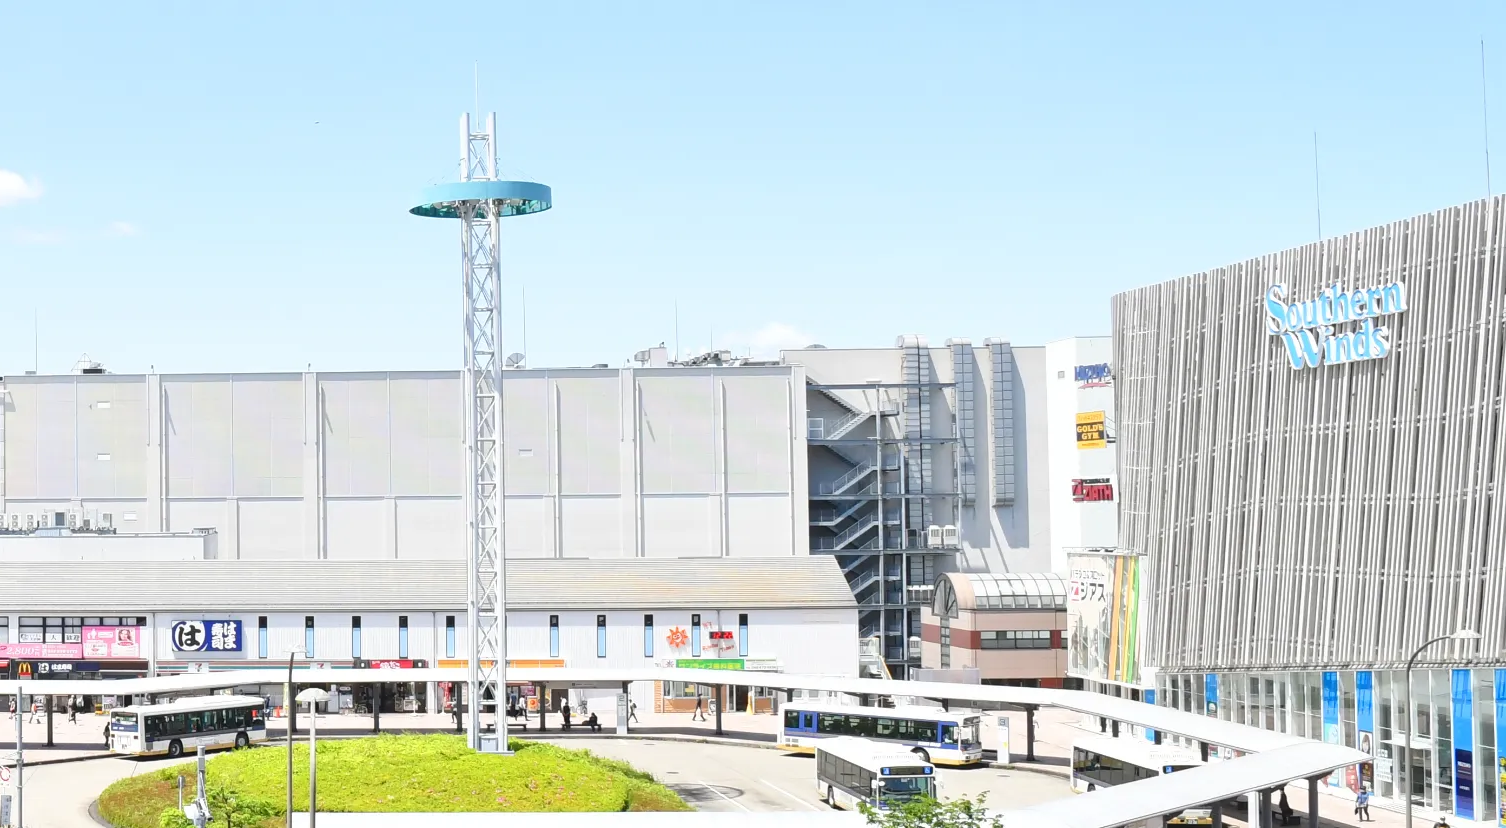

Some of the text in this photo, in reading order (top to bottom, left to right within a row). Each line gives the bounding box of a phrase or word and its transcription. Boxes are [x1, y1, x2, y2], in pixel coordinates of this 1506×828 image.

[1266, 281, 1408, 335] Southern
[1280, 318, 1391, 370] Winds
[1081, 432, 1100, 440] GYM
[1080, 581, 1106, 602] ジアス
[178, 624, 202, 647] は
